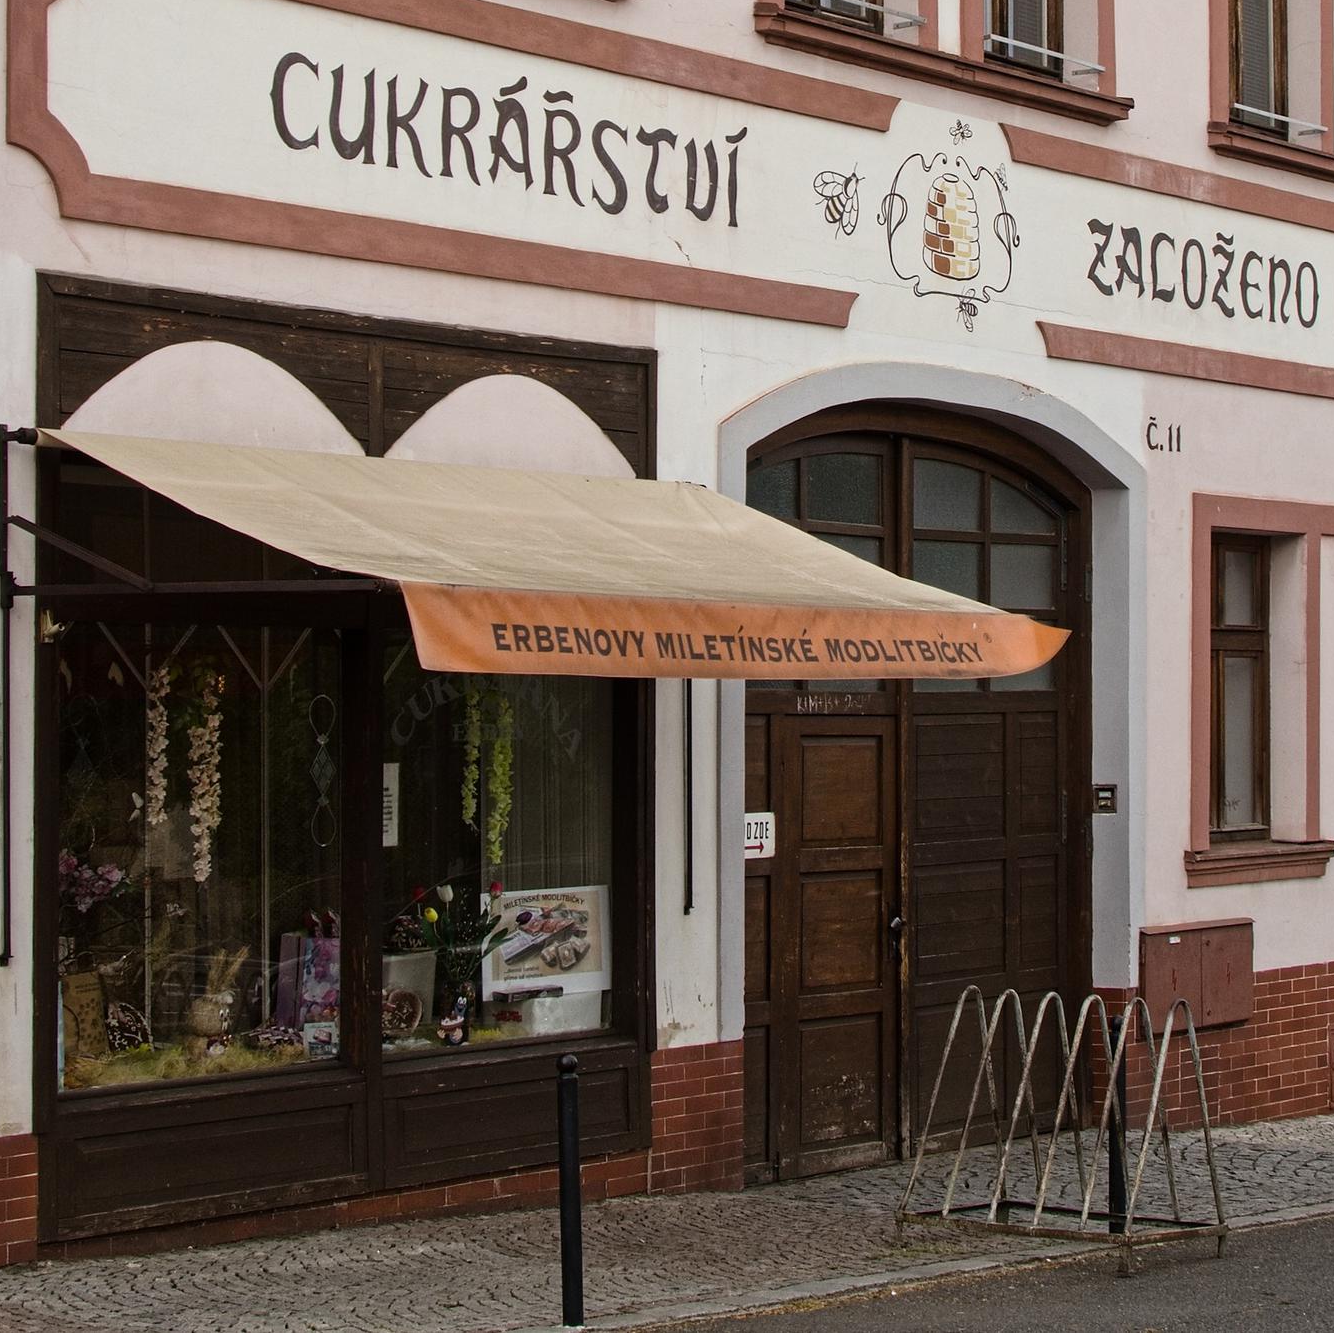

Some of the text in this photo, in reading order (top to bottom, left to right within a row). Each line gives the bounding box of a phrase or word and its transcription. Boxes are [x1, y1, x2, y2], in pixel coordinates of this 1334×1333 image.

[269, 52, 748, 228] CUKRÁŘSTVÍ
[1086, 218, 1320, 328] ZALOŽENO
[491, 623, 644, 658] ERBENOVY
[655, 625, 819, 663] MILETÍNSKÉ
[753, 821, 769, 840] ZDE
